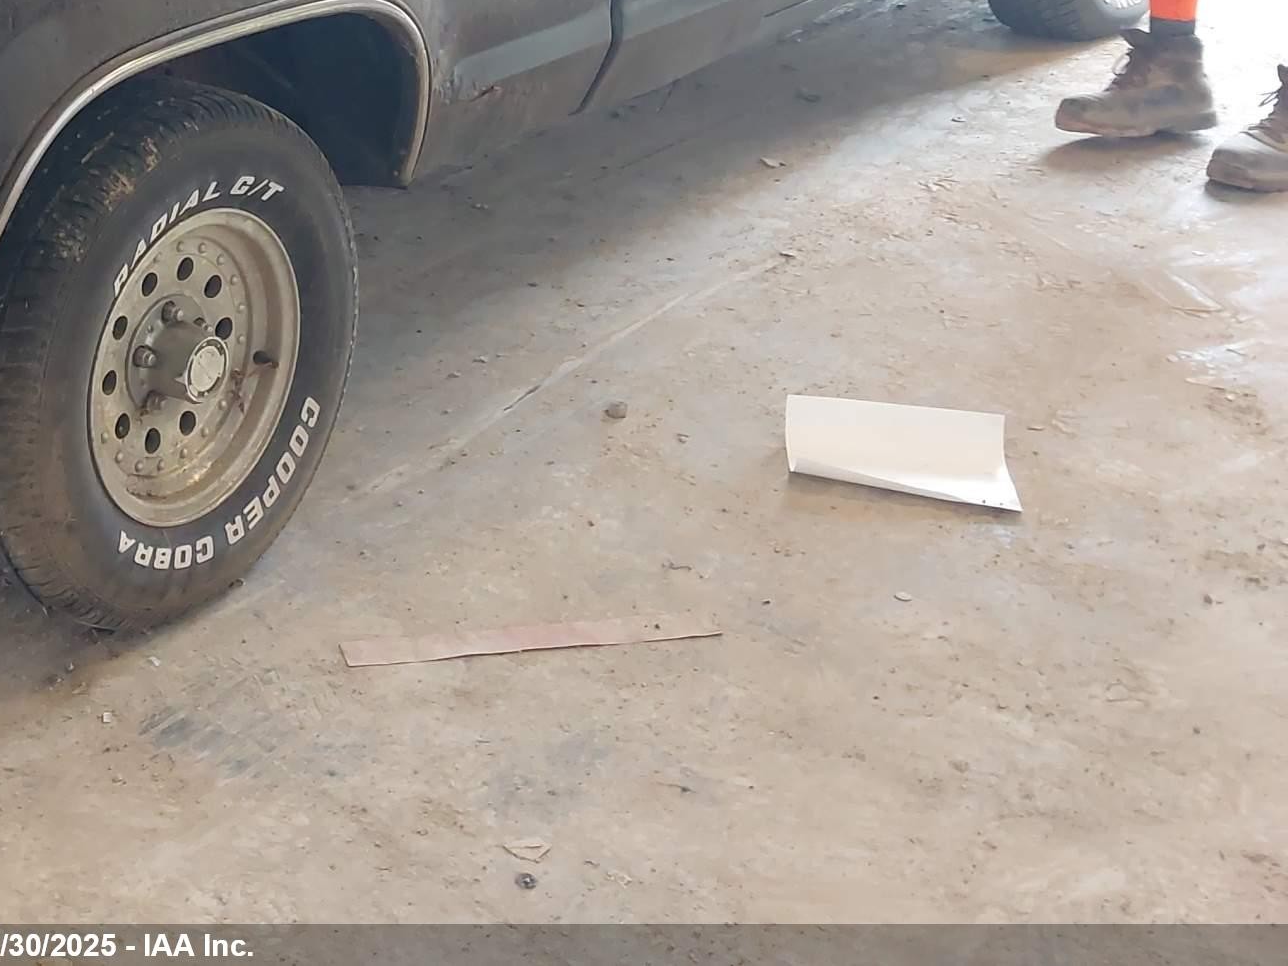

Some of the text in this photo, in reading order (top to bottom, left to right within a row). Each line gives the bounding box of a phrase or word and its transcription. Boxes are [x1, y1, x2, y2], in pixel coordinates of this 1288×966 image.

[114, 175, 285, 298] RADIAL G/T
[118, 396, 321, 570] COOPER COBRA
